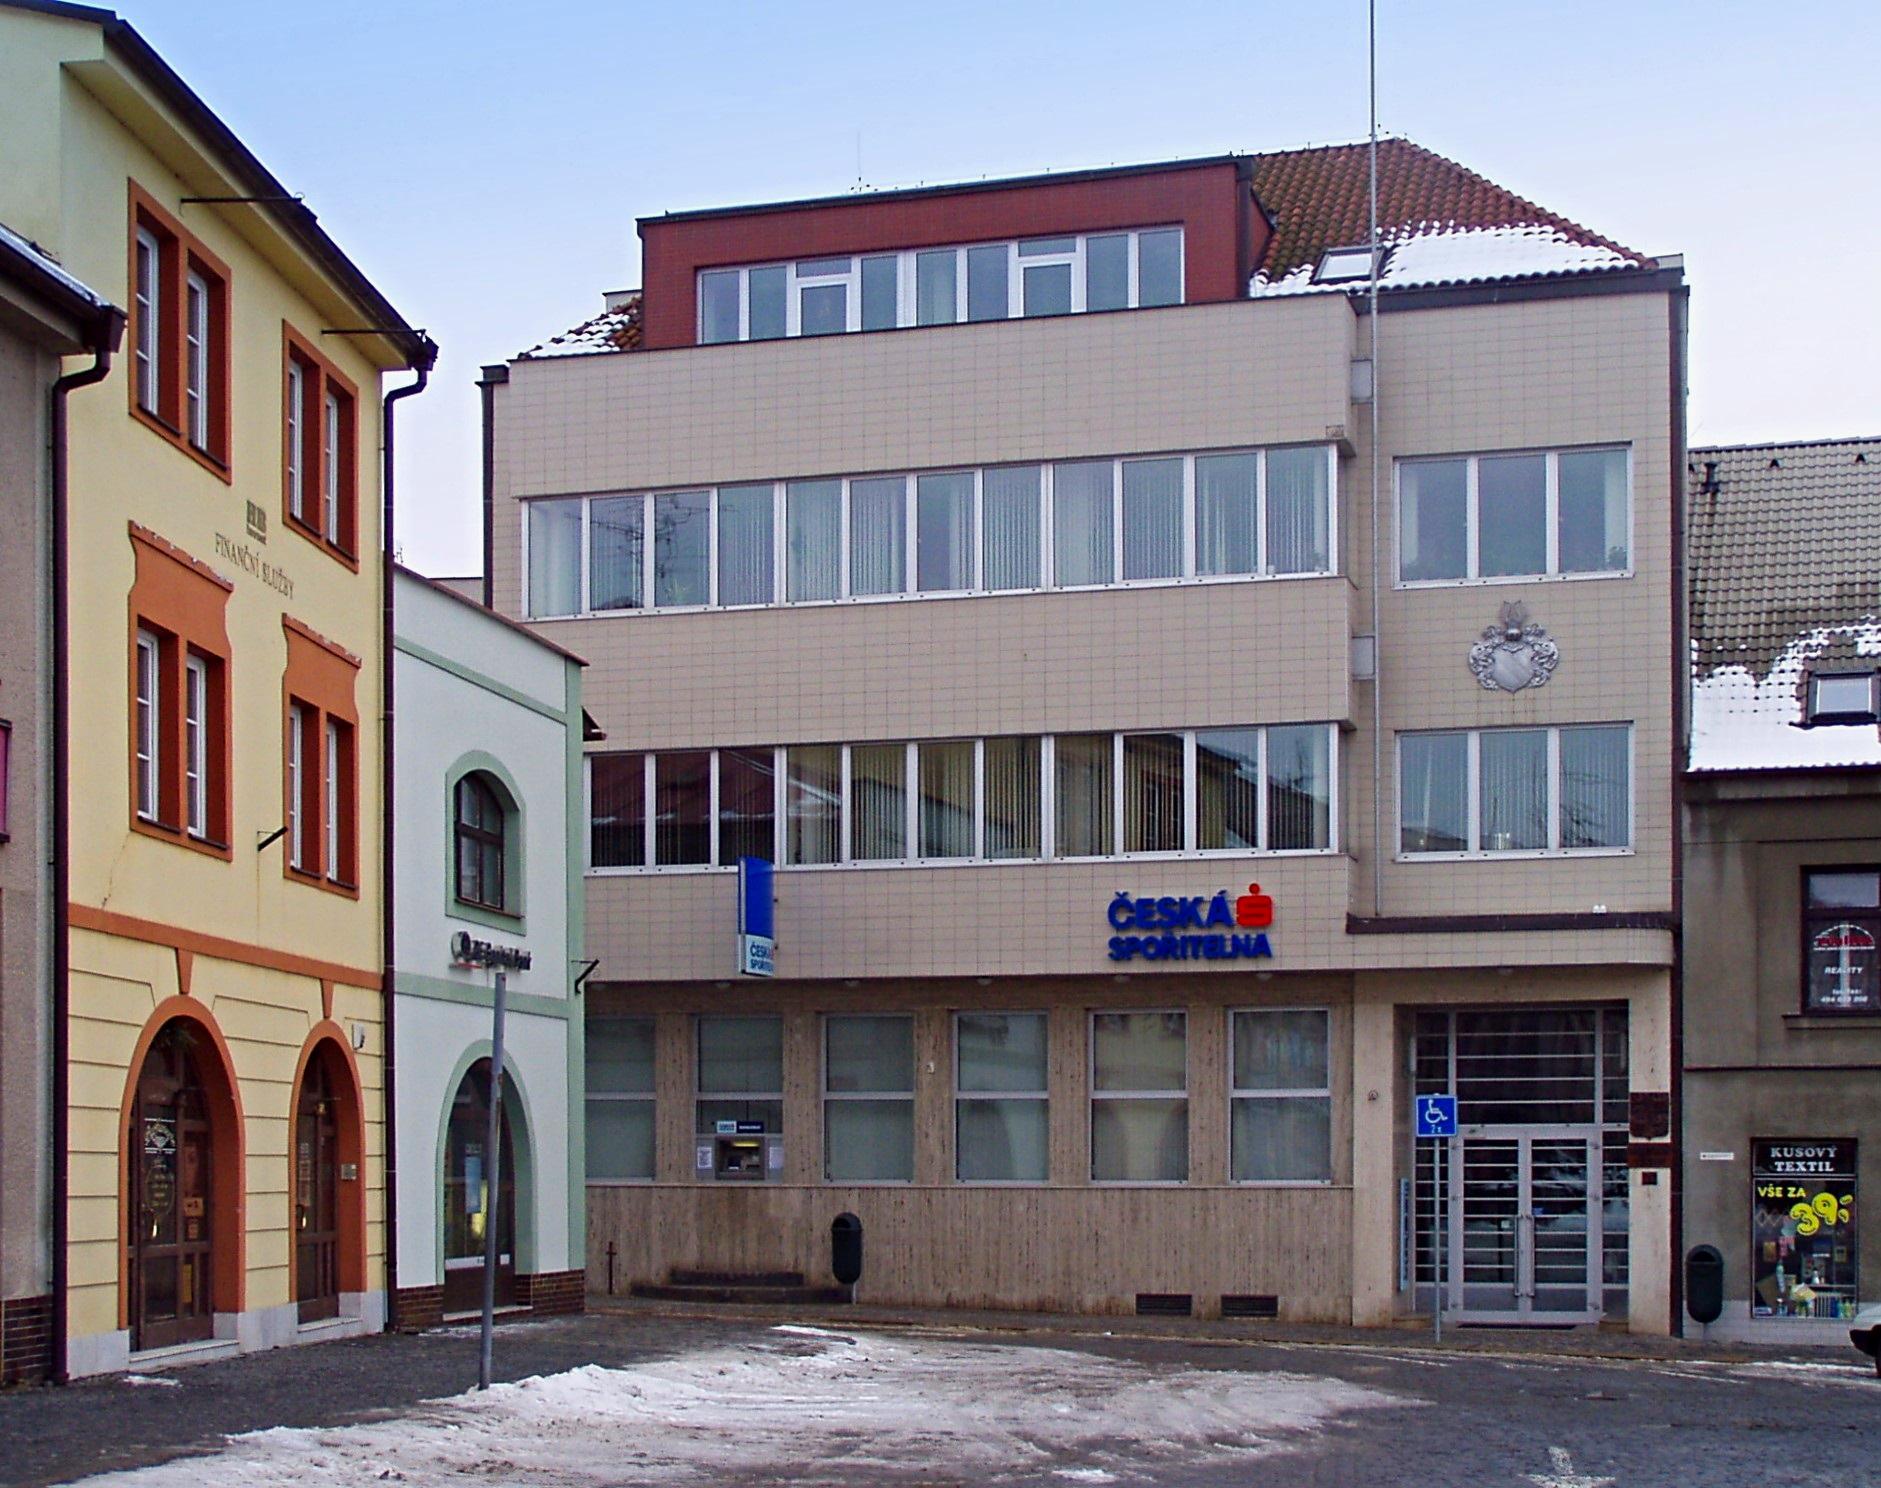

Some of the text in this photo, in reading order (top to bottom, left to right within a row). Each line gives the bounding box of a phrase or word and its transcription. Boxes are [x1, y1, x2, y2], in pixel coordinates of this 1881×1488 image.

[215, 532, 259, 578] FINANČNÍ
[1107, 890, 1235, 931] ČESKÁ
[1107, 930, 1273, 961] SPOŘITELNA
[1770, 1145, 1838, 1158] KUSOVÝ
[1774, 1161, 1834, 1172] TEXTIL
[1757, 1183, 1807, 1198] VŠE ZA
